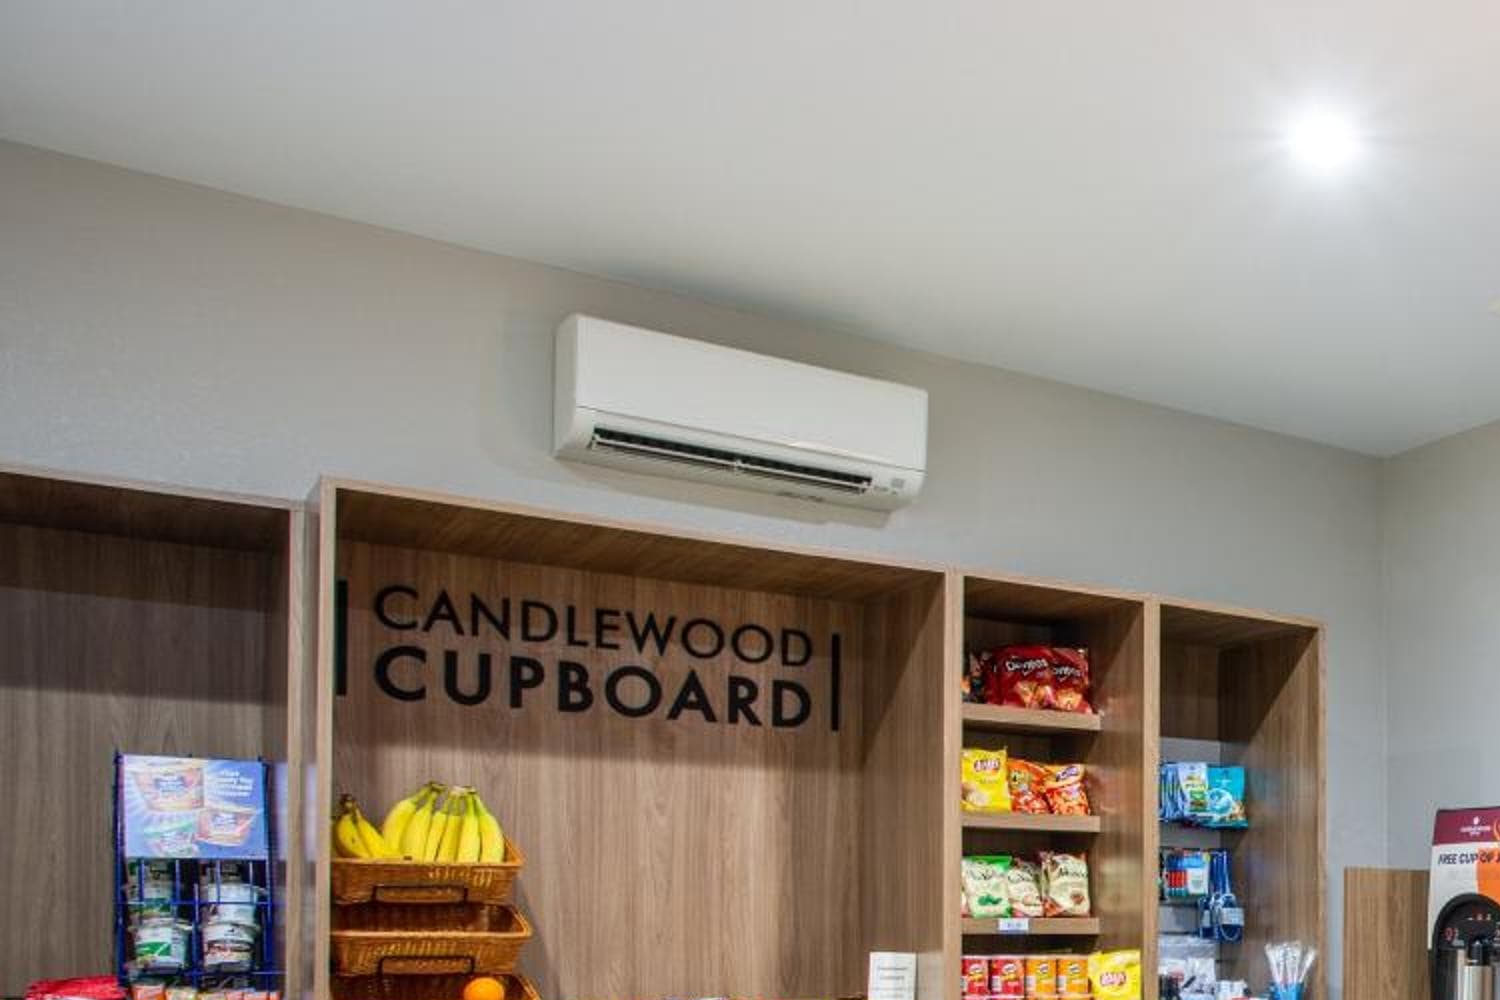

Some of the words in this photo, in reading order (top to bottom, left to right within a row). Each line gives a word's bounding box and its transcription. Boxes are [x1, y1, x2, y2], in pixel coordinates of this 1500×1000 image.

[373, 583, 813, 668] CANDLEWOOD
[374, 645, 812, 729] CUPBOARD
[1437, 852, 1457, 866] FREE
[1459, 852, 1478, 865] CUP
